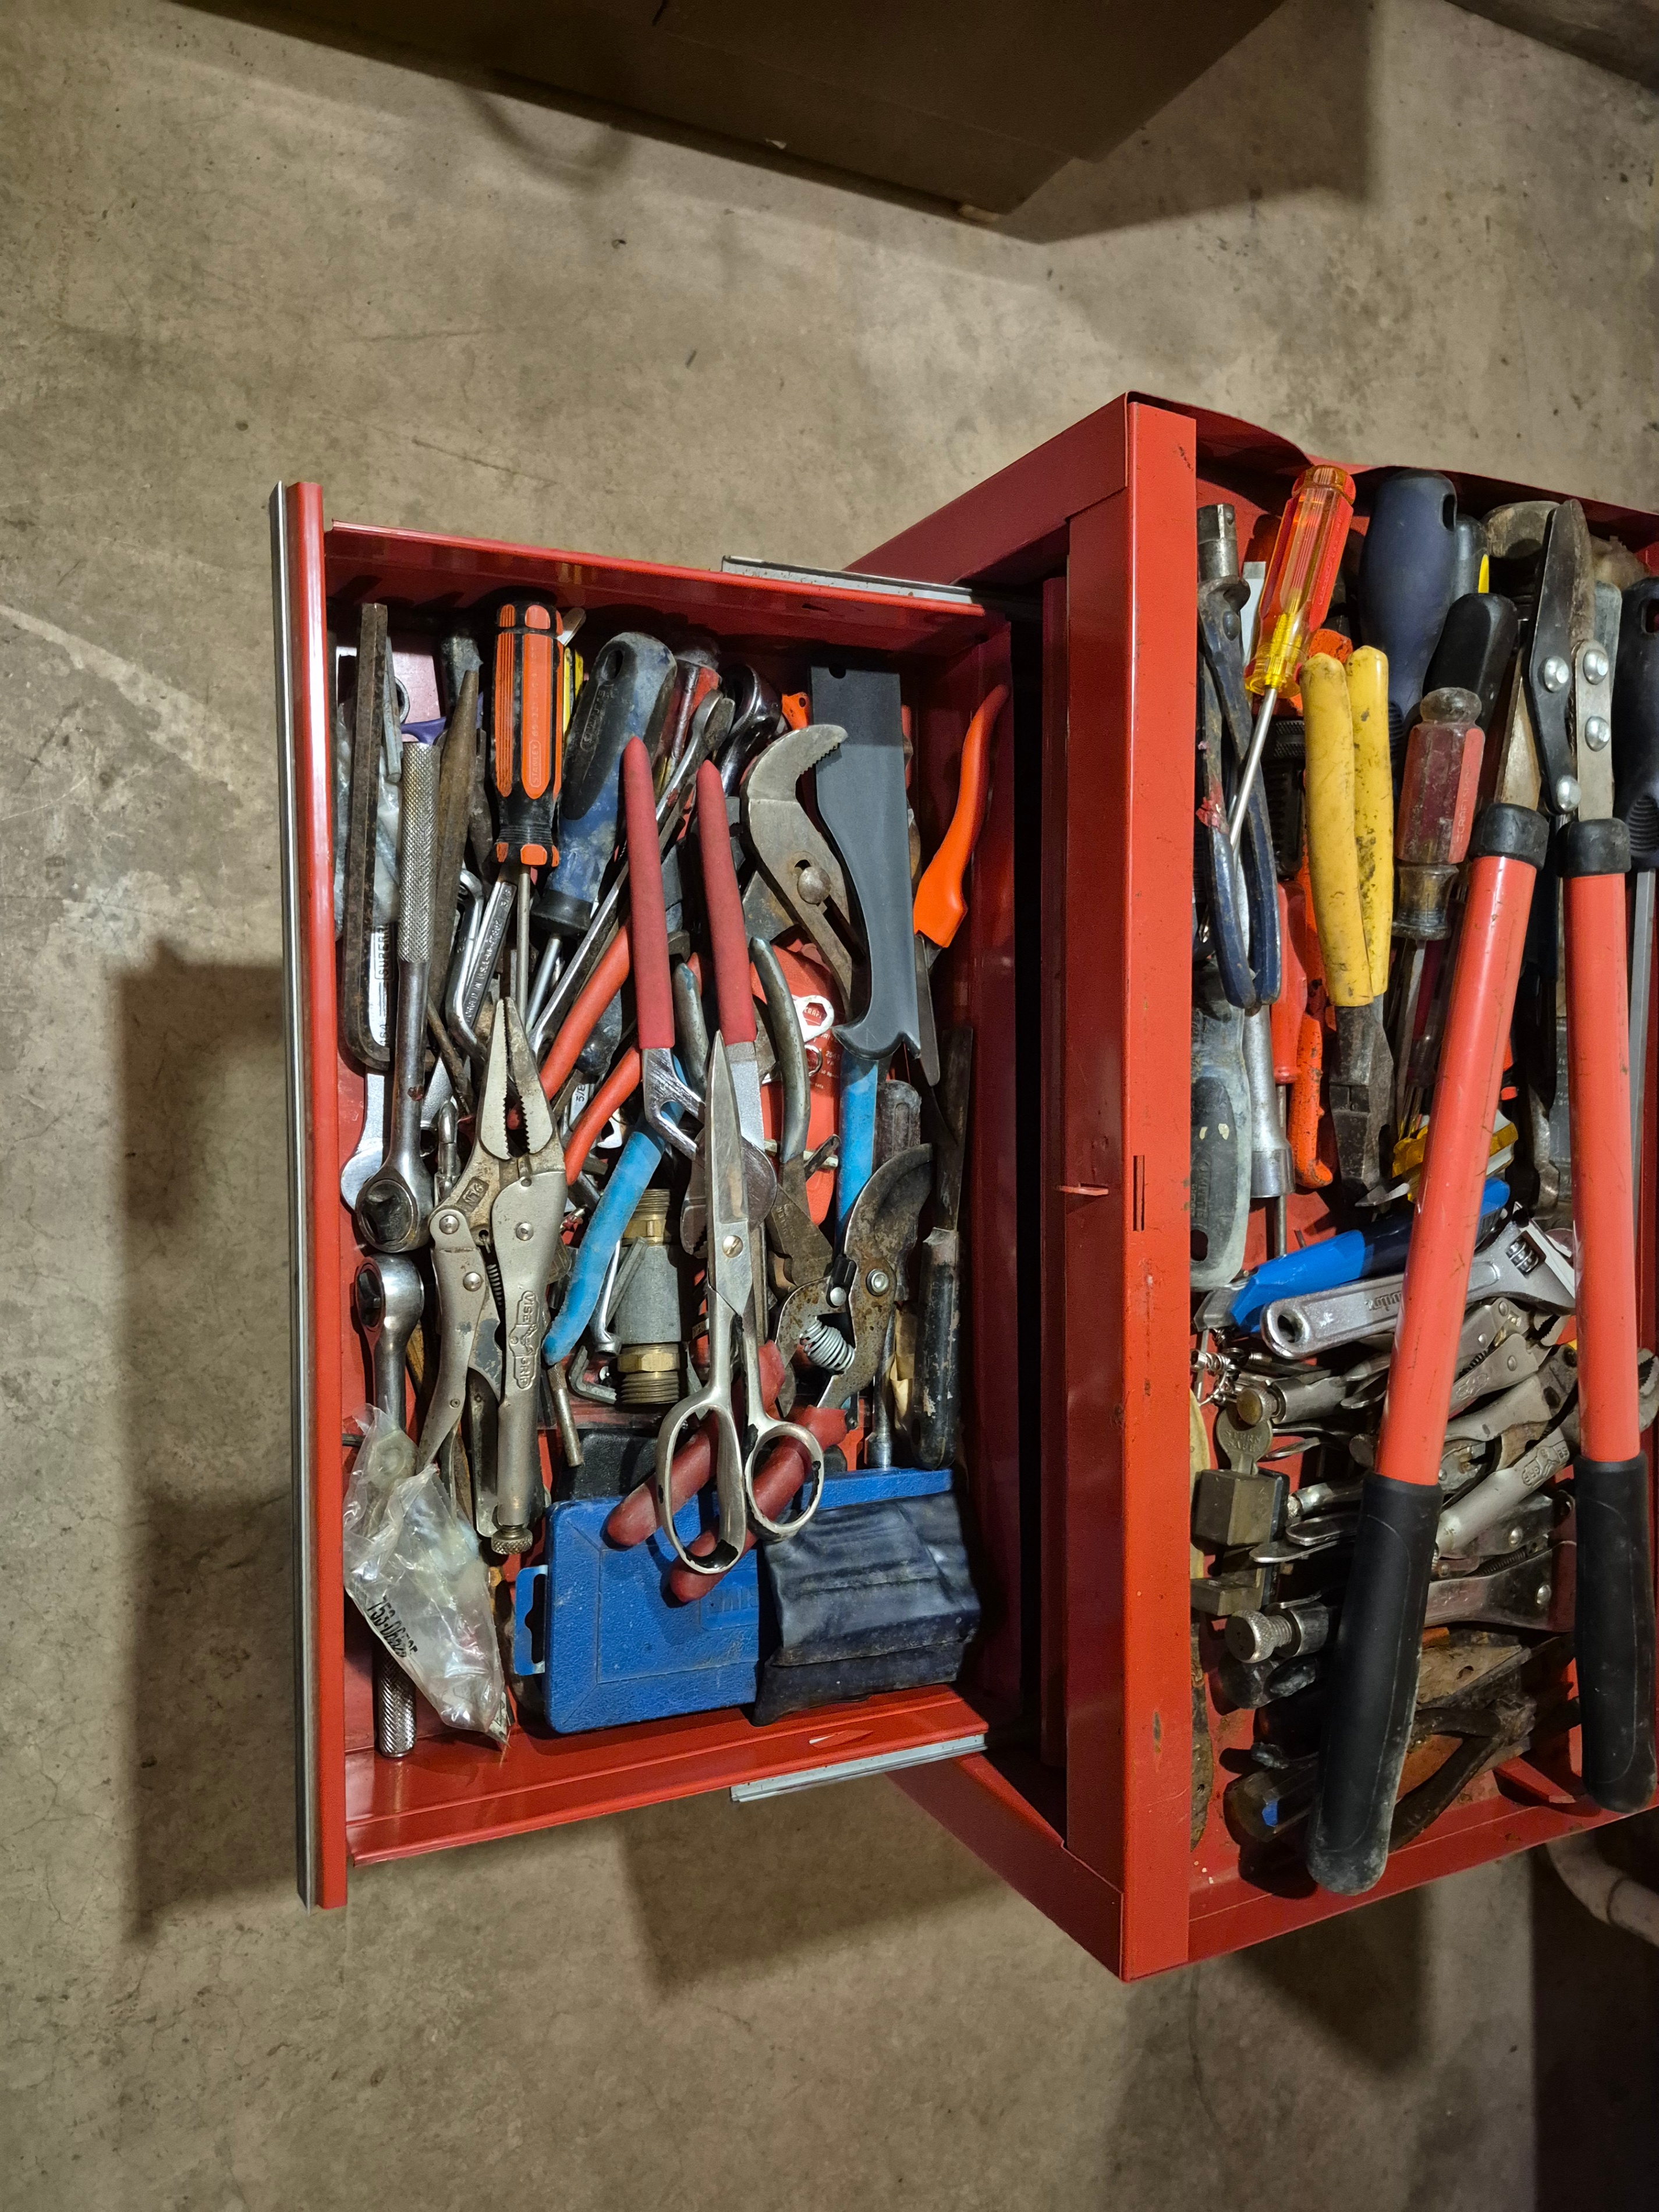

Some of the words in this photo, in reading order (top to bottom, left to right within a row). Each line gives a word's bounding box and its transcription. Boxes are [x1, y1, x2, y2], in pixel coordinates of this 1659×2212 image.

[531, 743, 540, 784] STANLEY
[523, 1291, 535, 1323] VISE
[519, 1356, 531, 1388] GRIP
[1524, 1466, 1541, 1484] GRIP
